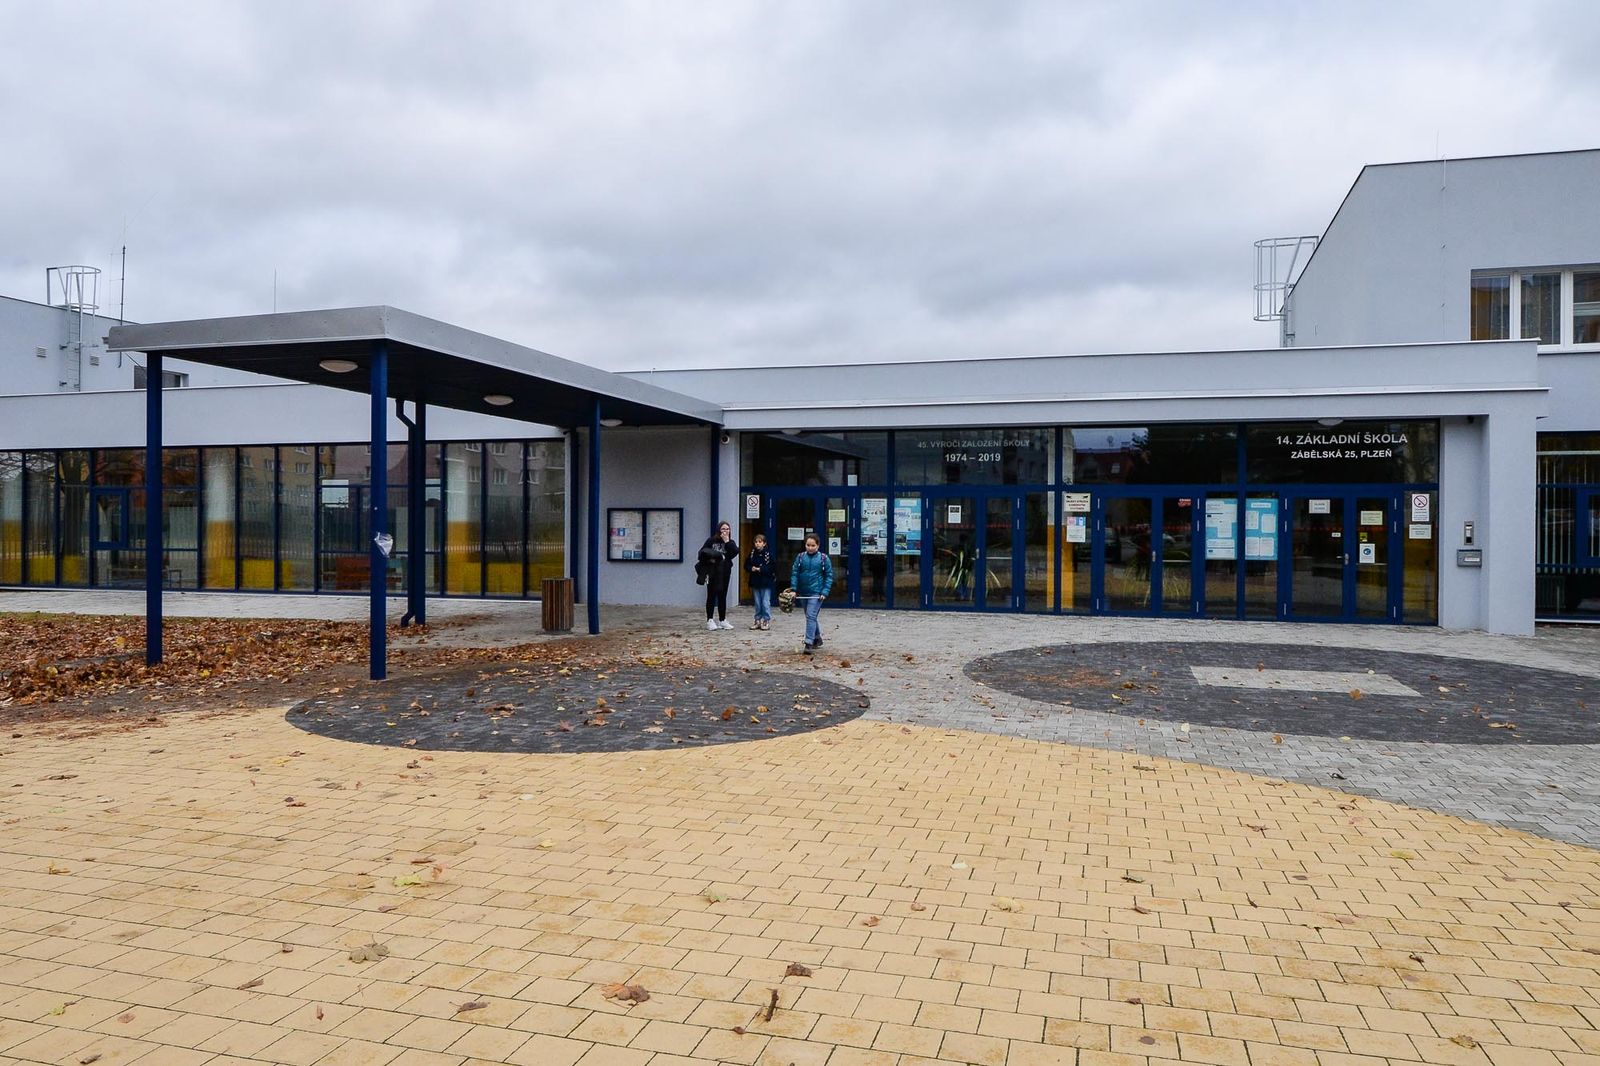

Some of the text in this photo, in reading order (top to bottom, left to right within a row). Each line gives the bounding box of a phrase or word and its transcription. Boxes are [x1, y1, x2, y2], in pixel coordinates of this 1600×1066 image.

[1276, 432, 1408, 445] 14. ZÁKLADNÍ ŠKOLA
[944, 453, 967, 462] 1974
[978, 452, 1001, 462] 2019
[1344, 450, 1358, 459] 25,
[1360, 448, 1392, 458] PLZEŇ
